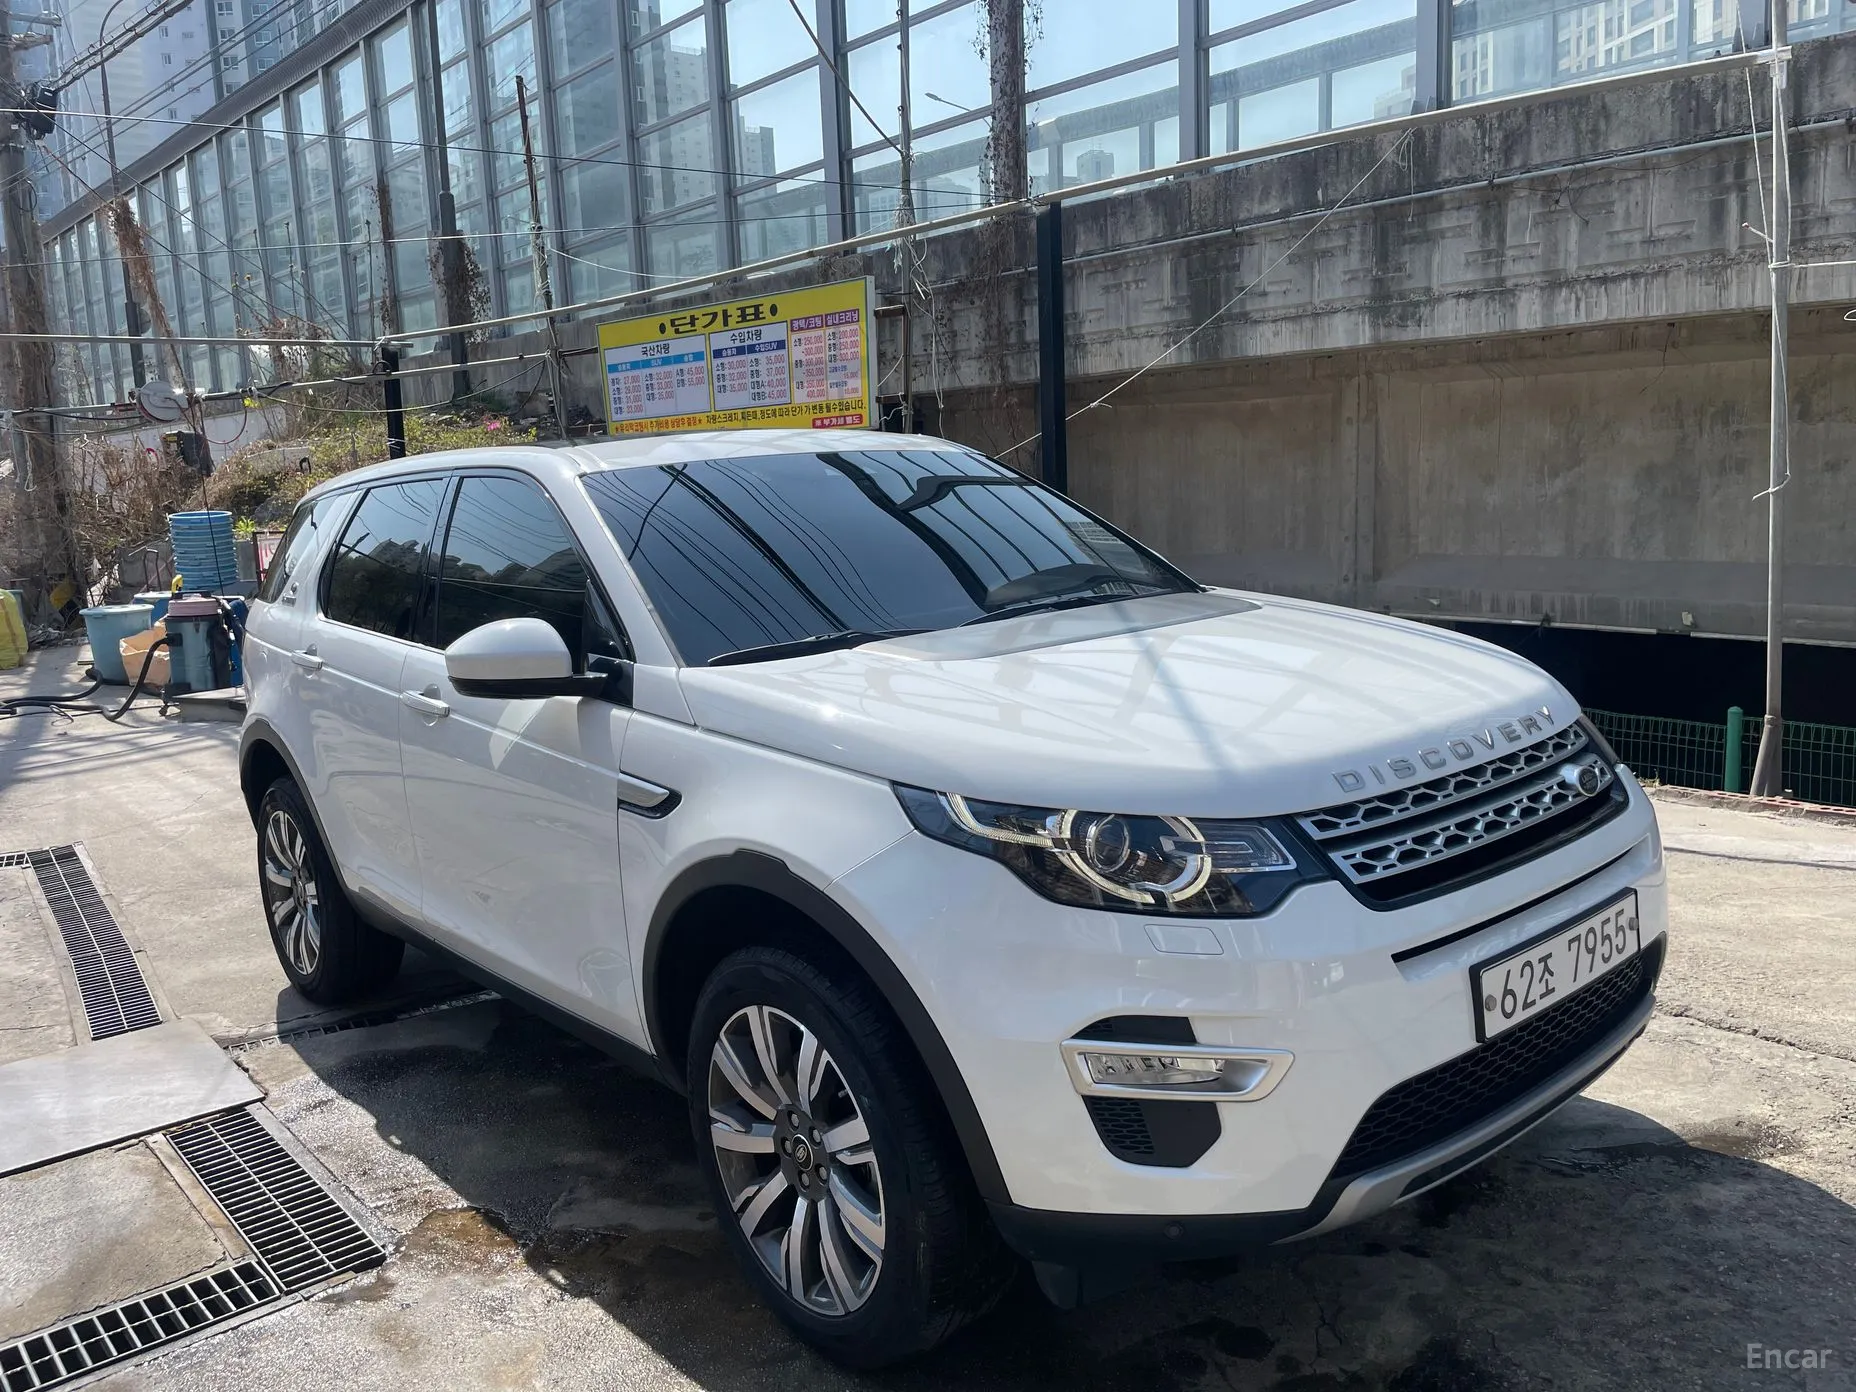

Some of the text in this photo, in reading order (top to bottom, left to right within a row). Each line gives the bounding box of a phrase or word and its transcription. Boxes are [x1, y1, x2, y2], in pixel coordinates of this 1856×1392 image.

[670, 304, 766, 334] 단가표
[792, 319, 822, 331] 광택/코팅
[826, 310, 859, 326] 실내크리닝
[730, 329, 762, 344] 수입차량
[641, 343, 670, 357] 국산차량
[755, 342, 778, 352] 수입SUV
[765, 354, 785, 365] 35,000
[766, 366, 786, 377] 37,000
[779, 407, 790, 417] 따라
[791, 406, 803, 416] 단가
[812, 404, 824, 414] 변동
[1331, 704, 1555, 793] DISCOVERY
[1500, 908, 1627, 1020] 62조 7955
